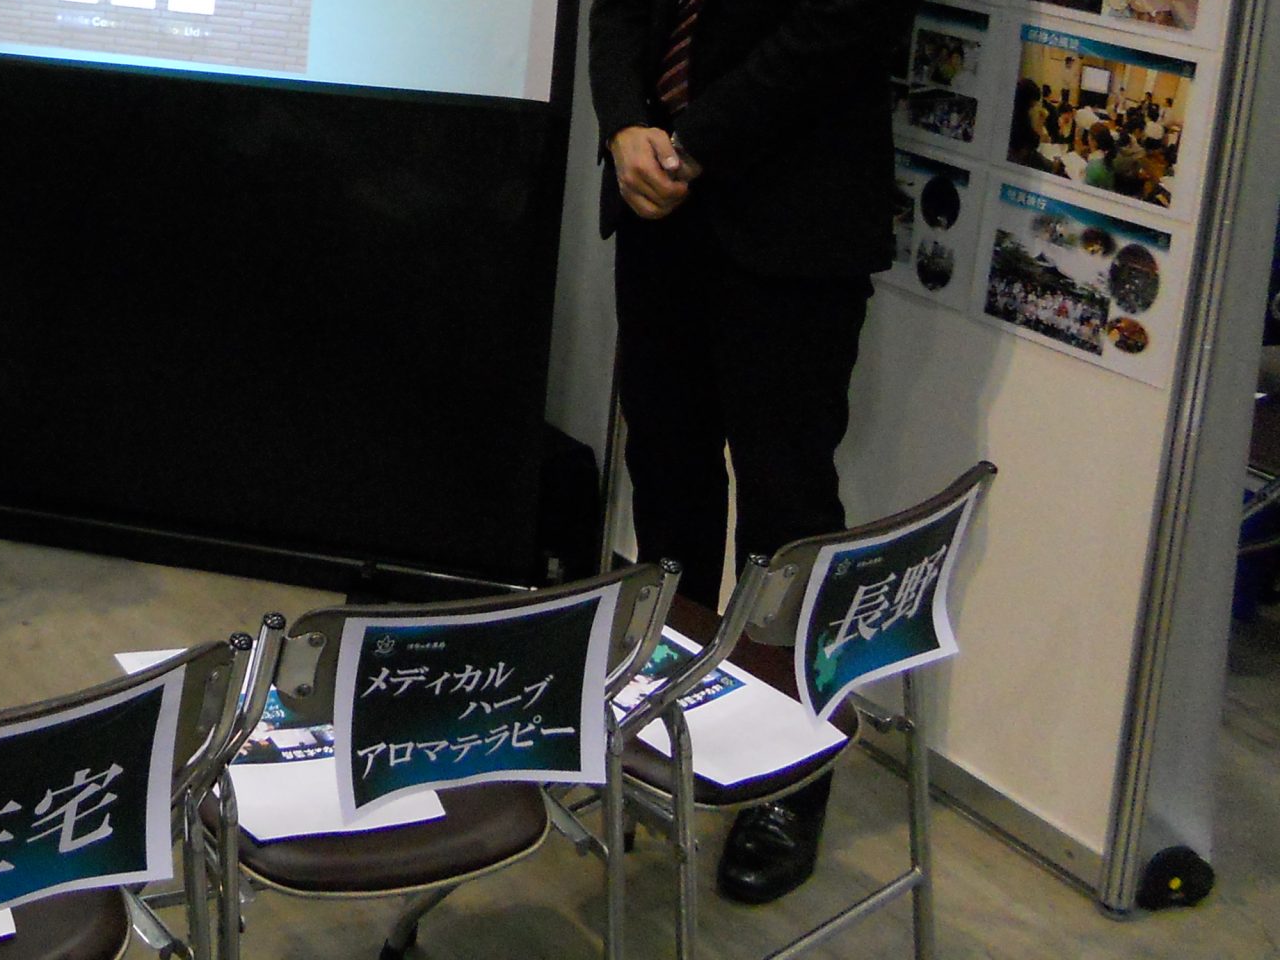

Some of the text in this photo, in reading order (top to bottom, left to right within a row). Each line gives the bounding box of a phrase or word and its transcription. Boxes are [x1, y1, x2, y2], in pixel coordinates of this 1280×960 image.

[825, 544, 947, 659] 長野
[360, 661, 516, 699] メディカル
[458, 673, 555, 721] ハーブ
[357, 715, 576, 780] アロマテラピー
